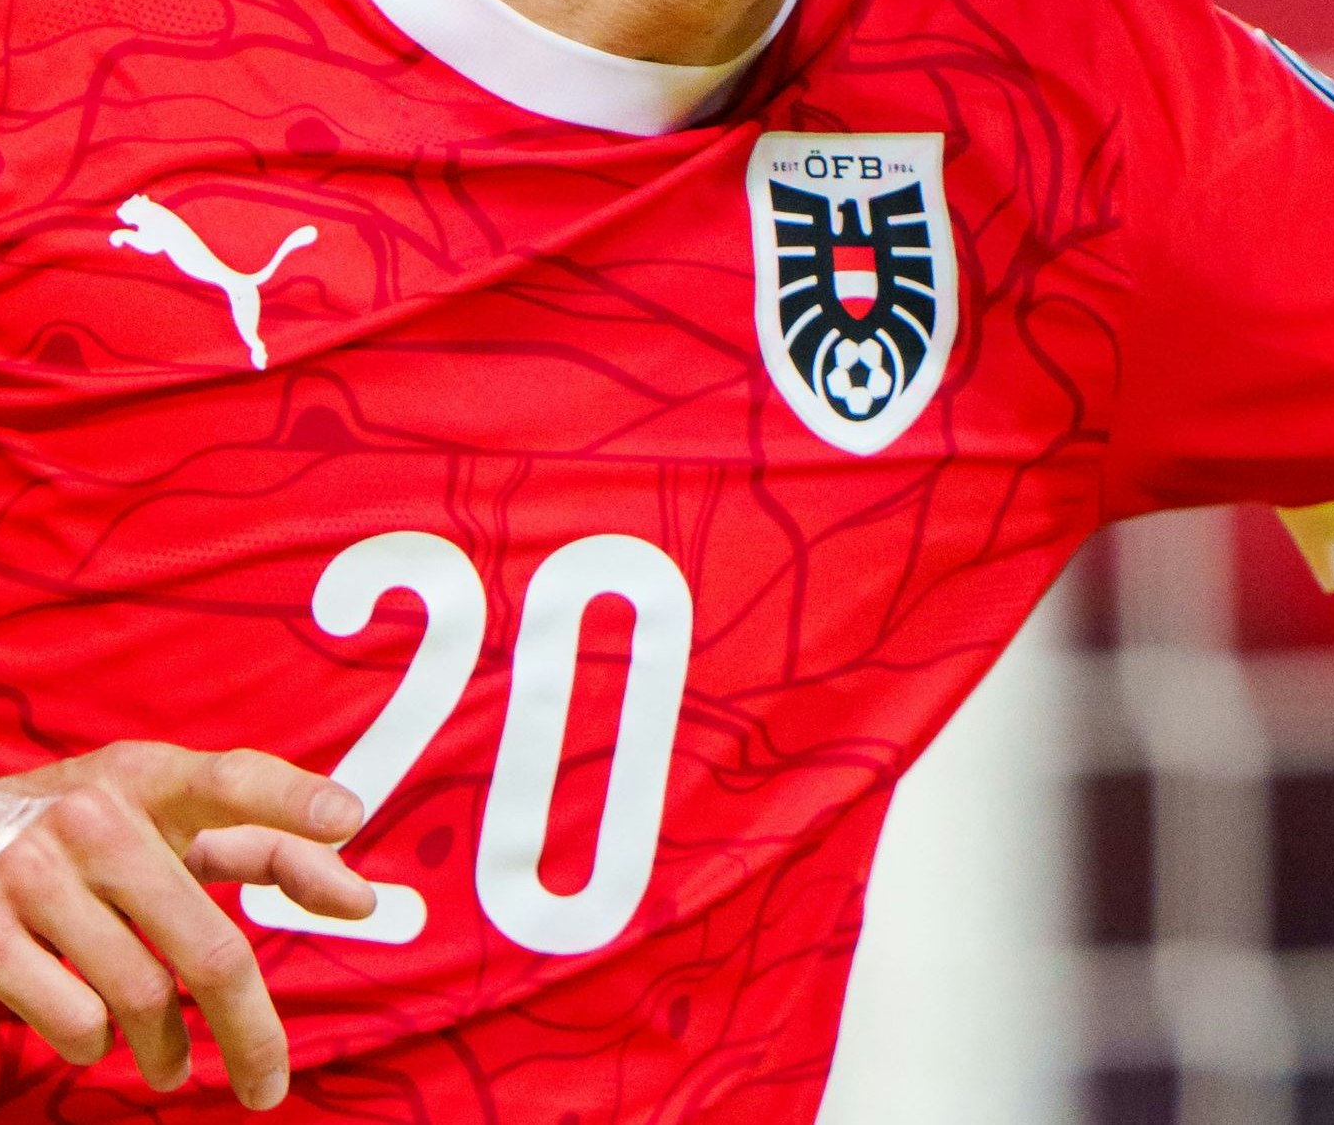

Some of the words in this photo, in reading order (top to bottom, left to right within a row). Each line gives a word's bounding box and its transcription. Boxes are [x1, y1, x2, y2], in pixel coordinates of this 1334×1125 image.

[772, 161, 799, 172] SEIT
[804, 149, 883, 180] ÖFB
[887, 162, 915, 173] 1904
[240, 531, 693, 956] 20
